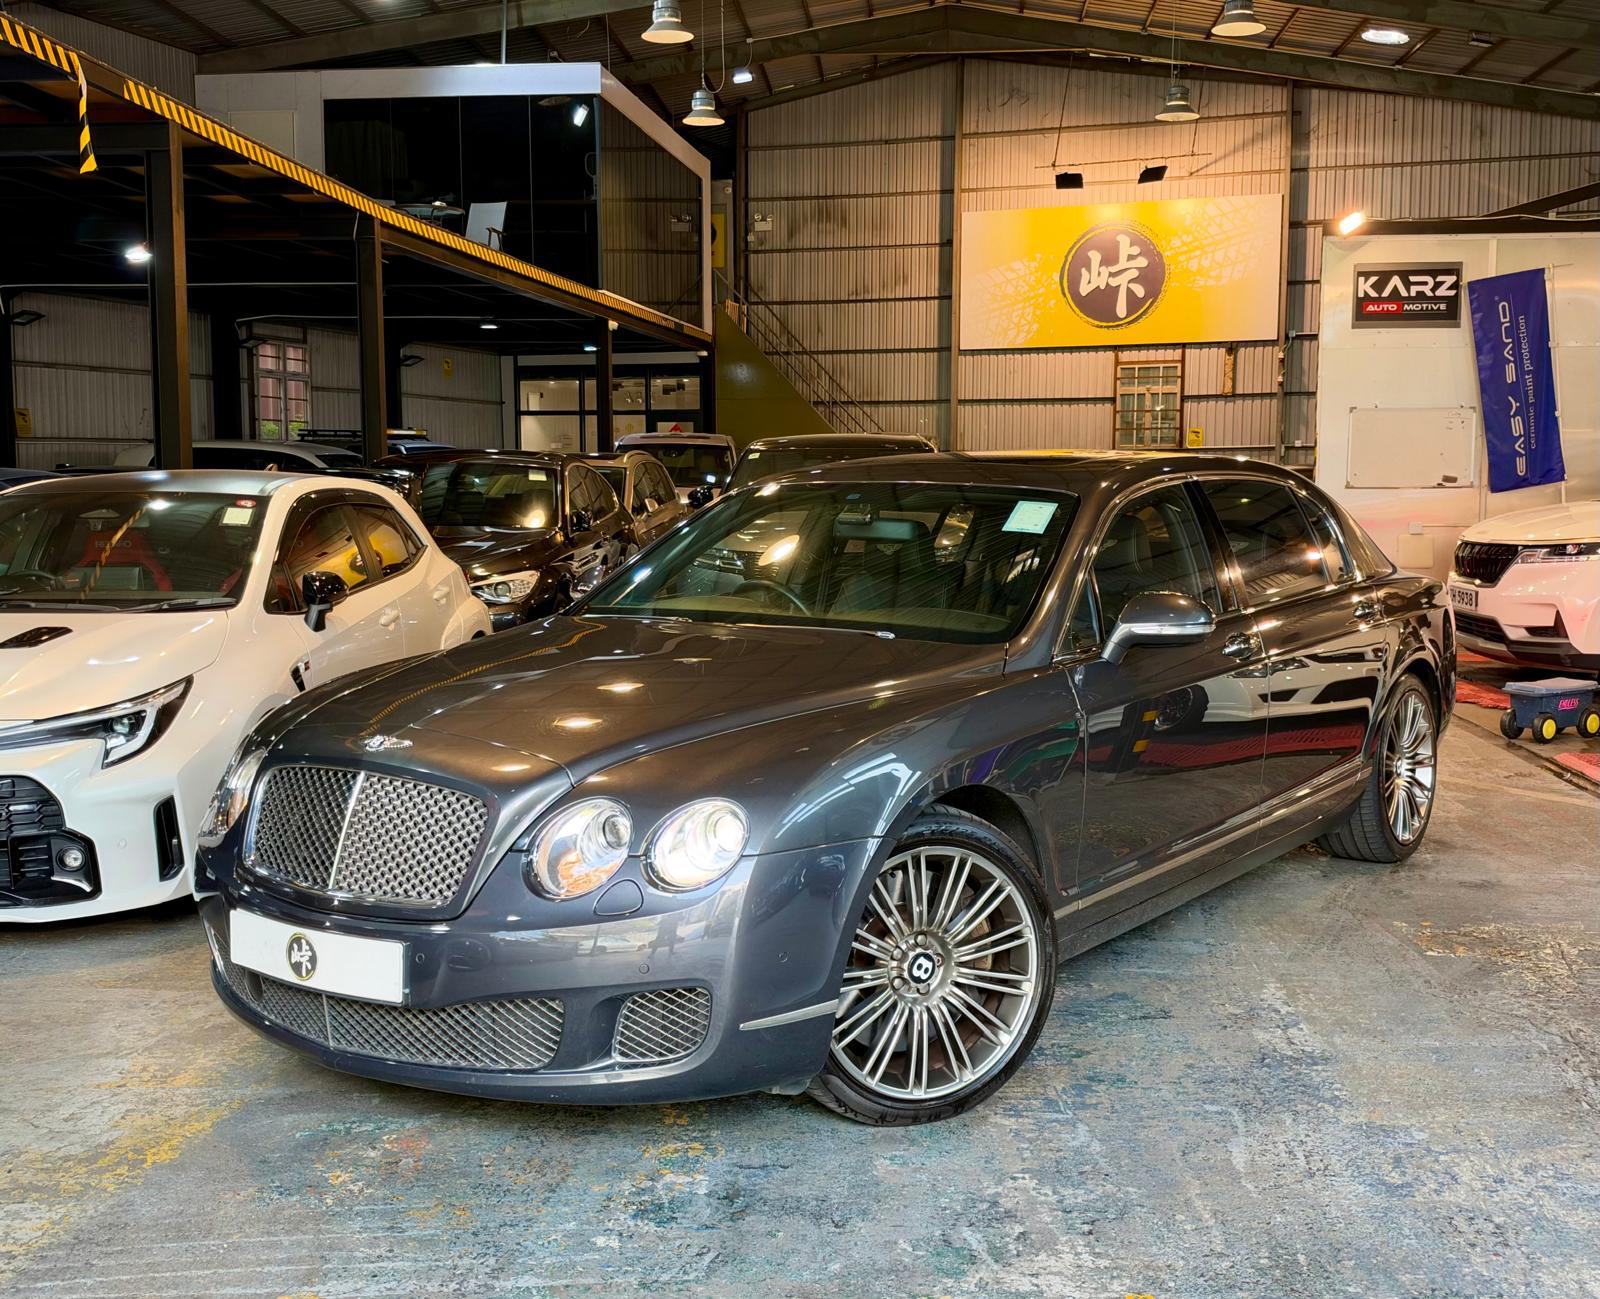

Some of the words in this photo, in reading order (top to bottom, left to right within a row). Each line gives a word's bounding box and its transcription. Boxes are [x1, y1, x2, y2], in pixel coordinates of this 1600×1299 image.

[1079, 234, 1148, 319] 峠
[1358, 275, 1458, 298] KARZ
[1366, 303, 1398, 312] AUTO
[1403, 303, 1447, 311] MOTIVE
[1499, 301, 1516, 384] SAND
[1518, 315, 1534, 371] protection
[1525, 373, 1537, 404] paint
[1508, 396, 1526, 476] EASY
[1527, 406, 1537, 449] ceramic
[1457, 590, 1474, 607] 5938
[291, 939, 312, 978] 峠
